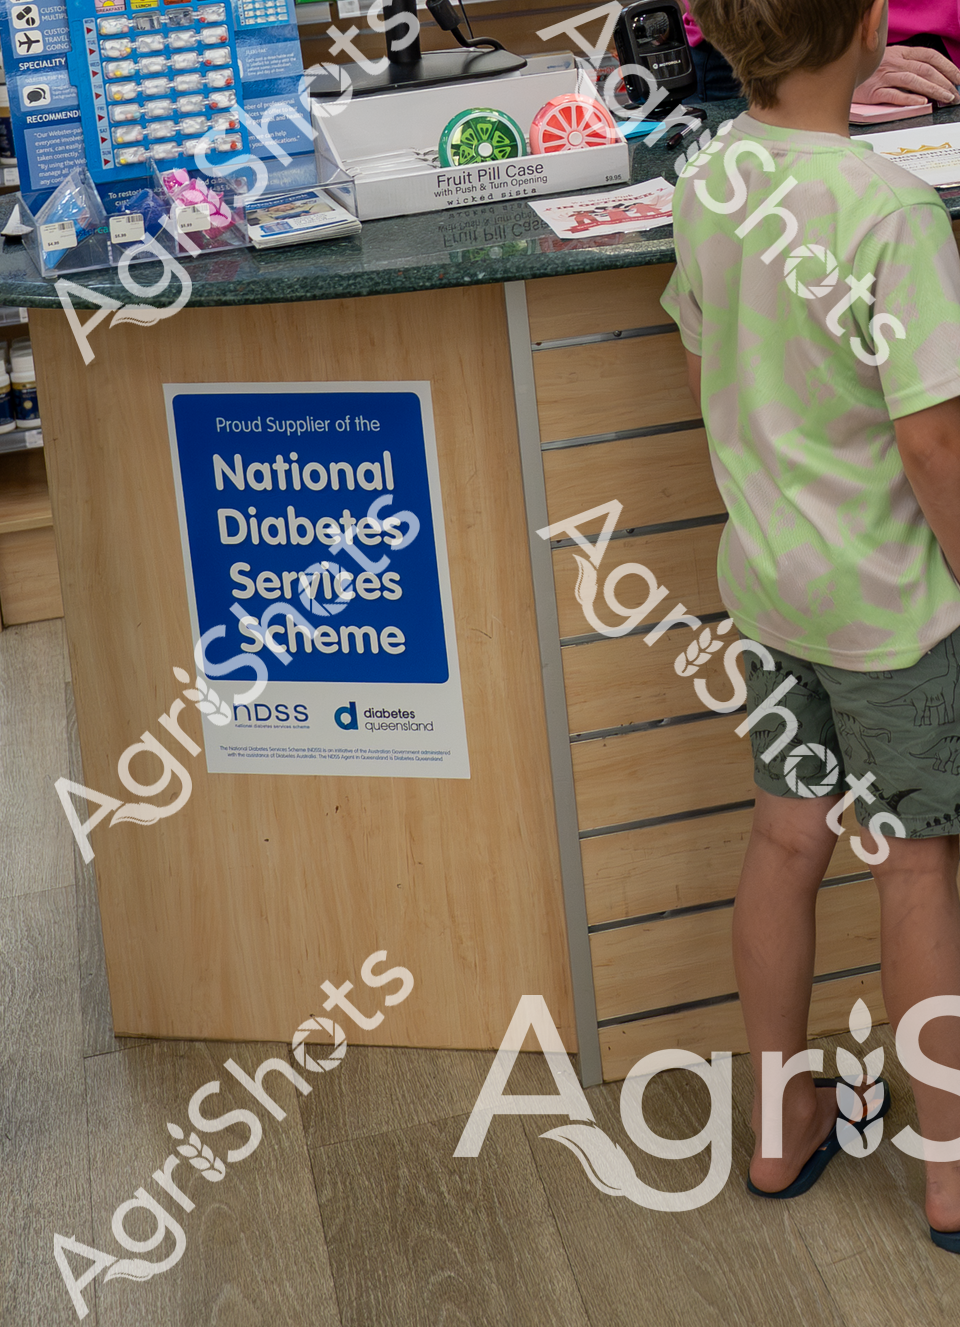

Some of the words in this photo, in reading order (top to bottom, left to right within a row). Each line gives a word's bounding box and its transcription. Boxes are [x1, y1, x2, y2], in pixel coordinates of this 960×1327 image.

[46, 43, 69, 51] GOING
[19, 58, 66, 71] SPECIALITY
[27, 110, 80, 124] RECOMMEND
[437, 171, 473, 188] Fruit
[478, 166, 500, 183] Pill
[506, 163, 544, 178] Case
[605, 174, 622, 182] $9.95
[434, 188, 453, 198] with
[455, 185, 477, 195] Push
[489, 181, 508, 190] Turn
[510, 175, 548, 188] Opening
[447, 193, 494, 206] wicked
[501, 188, 537, 198] sista
[216, 416, 262, 432] Proud
[266, 415, 330, 436] Supplier
[335, 415, 350, 432] of
[354, 415, 380, 432] the
[212, 450, 394, 491] National
[217, 506, 404, 546] Diabetes
[230, 561, 402, 600] Services
[238, 614, 406, 654] Scheme
[364, 708, 416, 719] diabetes
[365, 721, 434, 732] queensland
